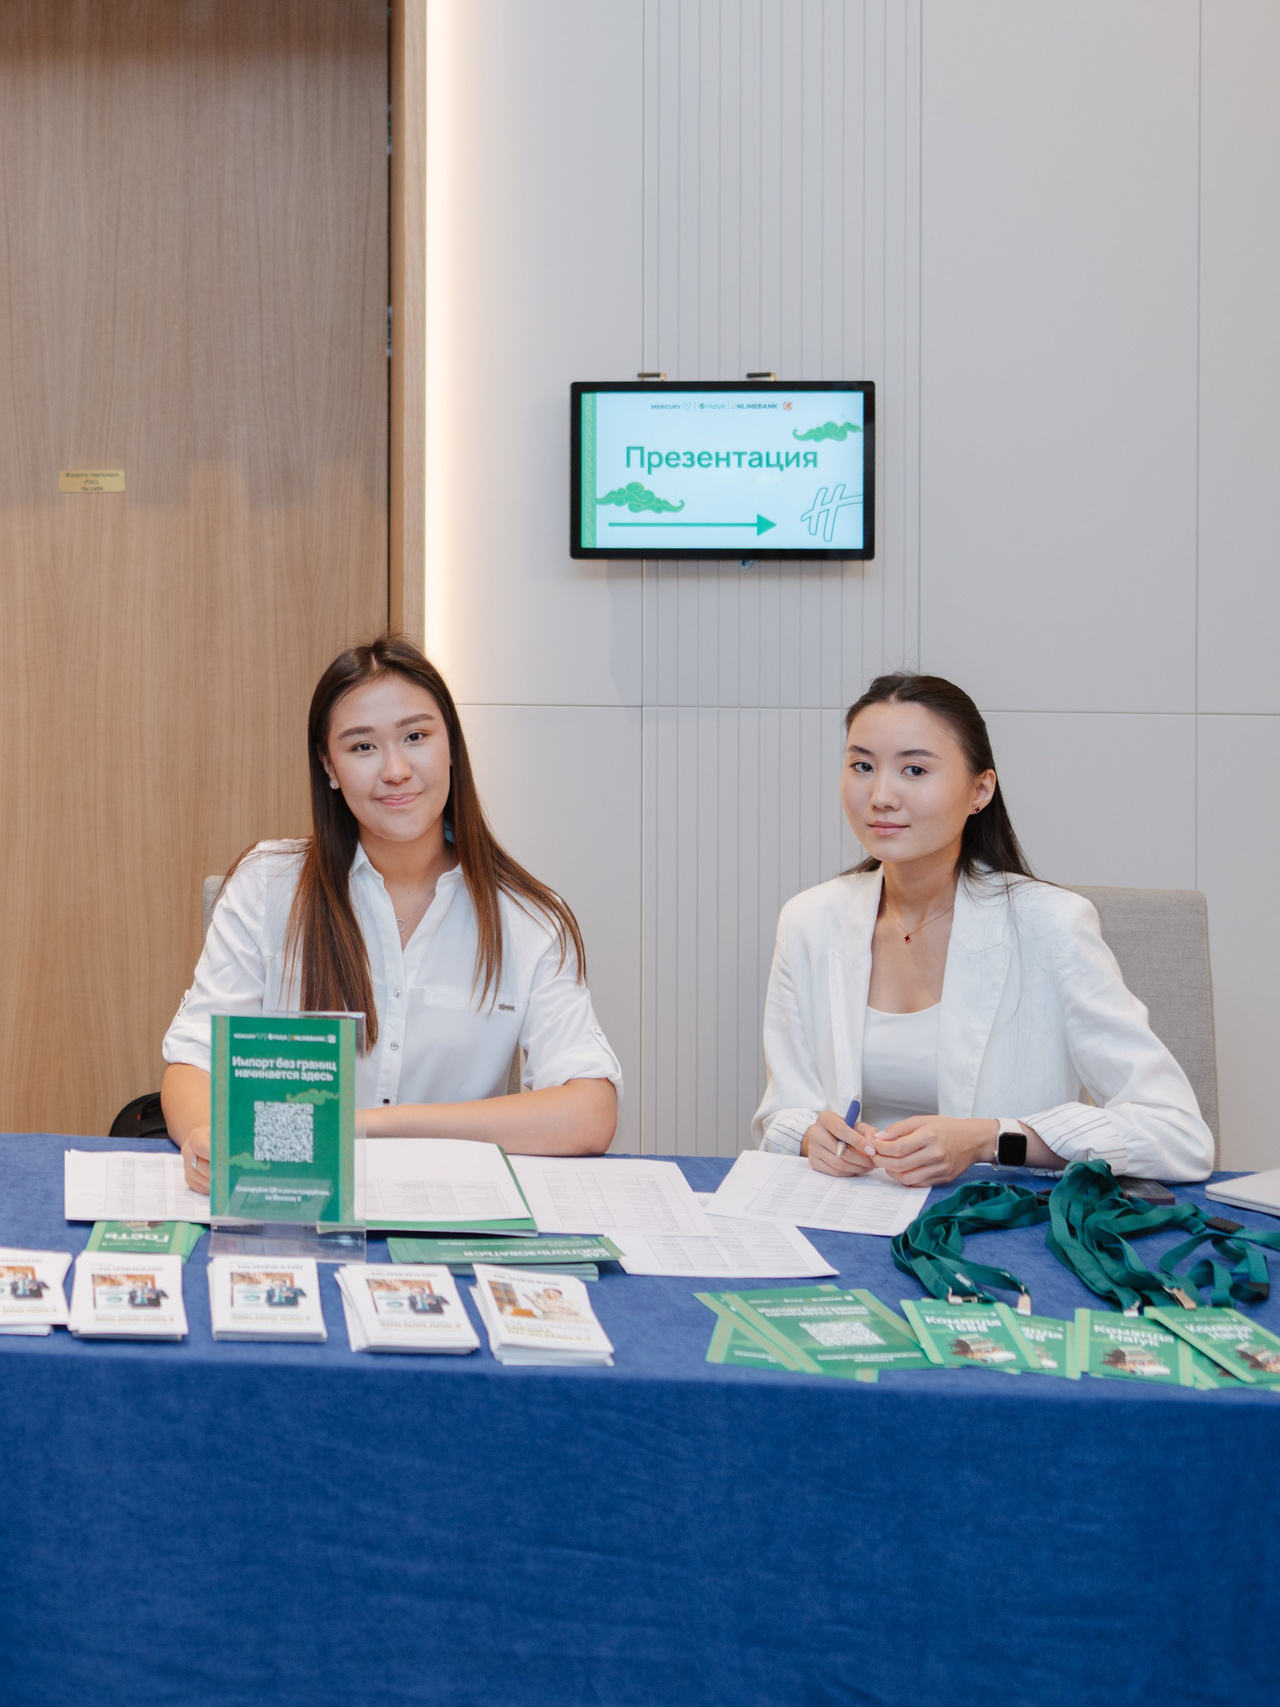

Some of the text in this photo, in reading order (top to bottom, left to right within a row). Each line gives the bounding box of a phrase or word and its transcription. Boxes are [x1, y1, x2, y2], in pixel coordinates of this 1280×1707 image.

[706, 402, 726, 412] Halyk
[625, 446, 819, 476] Презентация
[232, 1056, 337, 1073] Импорт без границ
[235, 1068, 334, 1082] начинается здесь
[104, 1232, 169, 1243] Гость
[924, 1315, 1002, 1328] Команда
[1093, 1324, 1175, 1344] Команда
[1109, 1333, 1160, 1348] Halyk
